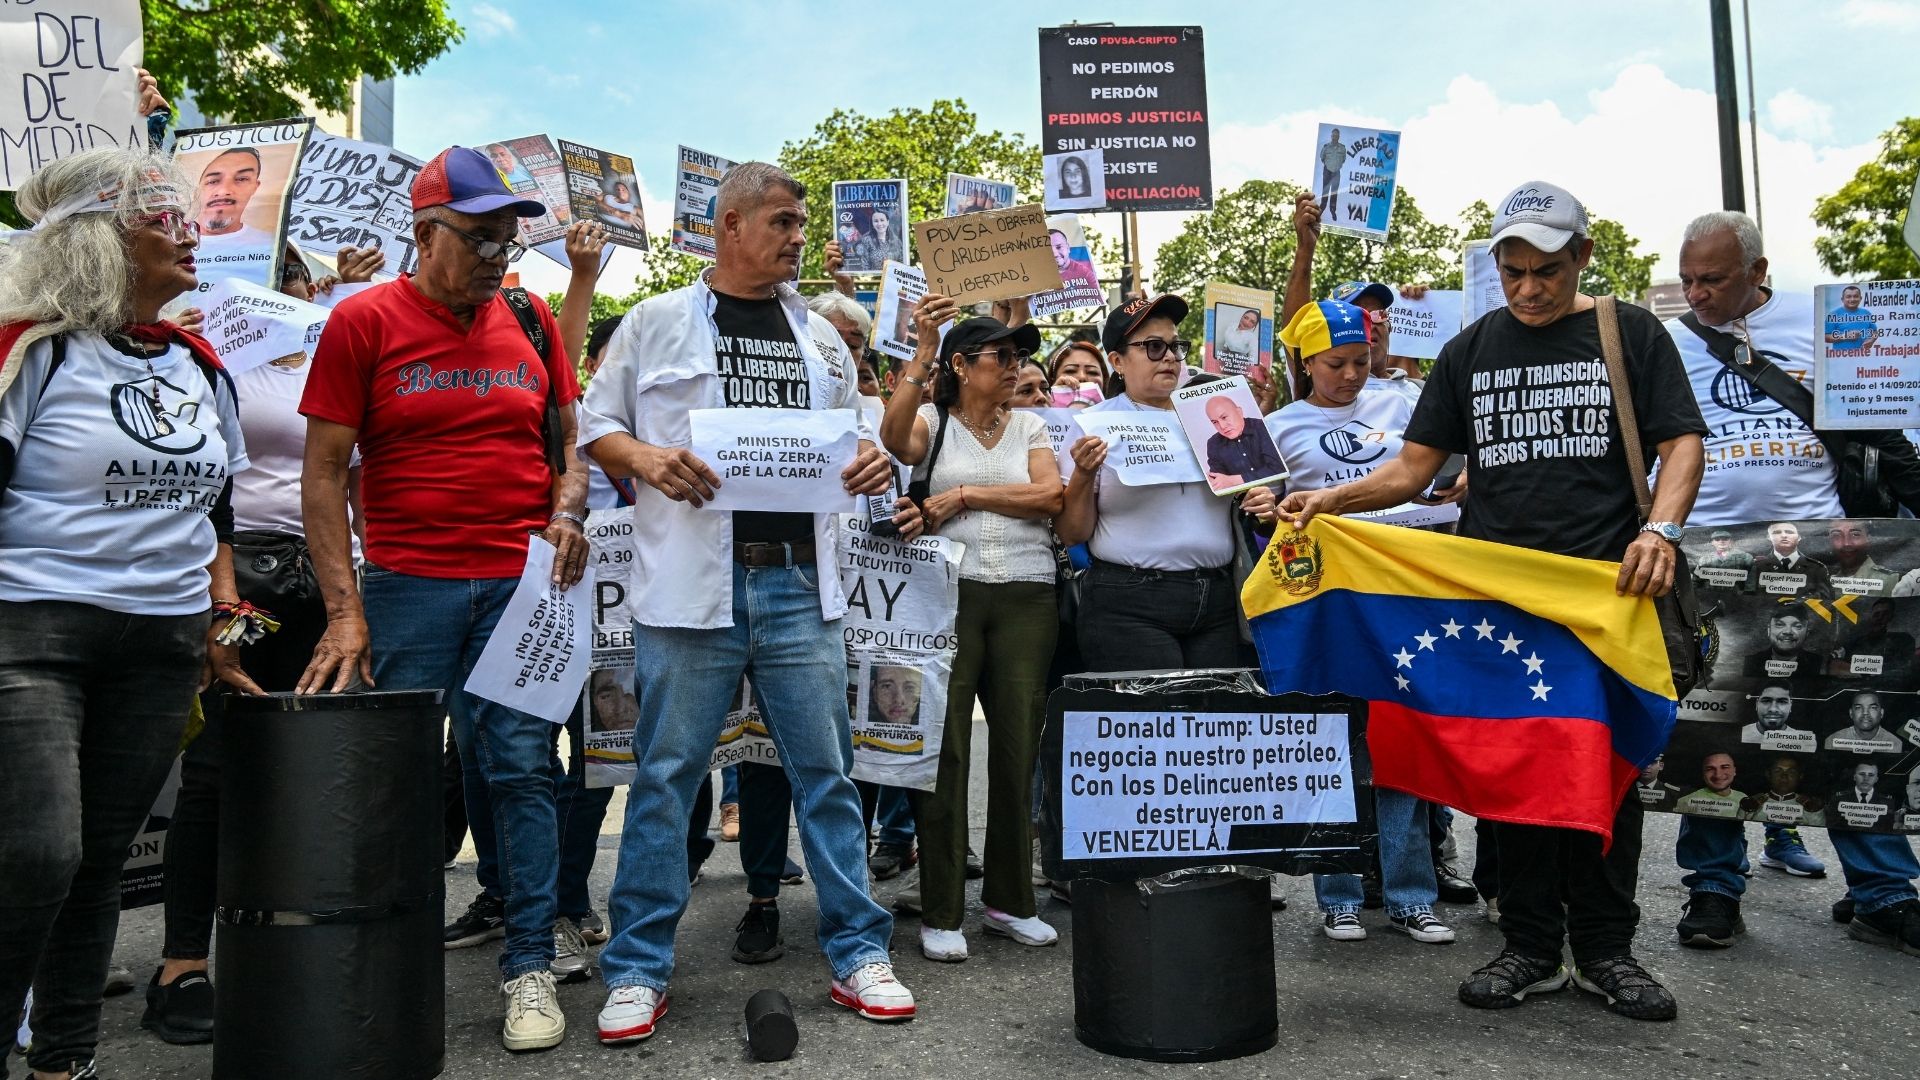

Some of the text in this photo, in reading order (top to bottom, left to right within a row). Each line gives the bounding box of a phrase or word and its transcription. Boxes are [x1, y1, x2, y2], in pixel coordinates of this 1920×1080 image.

[35, 12, 119, 71] DEL
[1068, 36, 1177, 46] CASO PDVSA-CRIPTO
[1072, 61, 1175, 75] NO PEDIMOS
[23, 72, 75, 123] DE
[1091, 84, 1158, 99] PERDÓN
[1048, 110, 1203, 125] PEDIMOS JUSTICIA
[562, 141, 598, 159] LIBERTAD
[1057, 135, 1196, 151] SIN JUSTICIA NO
[1347, 136, 1394, 160] LIBERTAD
[521, 152, 548, 166] AYUDA
[565, 153, 600, 170] KLEIBER
[681, 148, 719, 169] FERNEY
[1359, 156, 1384, 169] PARA
[1103, 161, 1158, 175] EXISTE
[1349, 171, 1388, 187] LERMITH
[837, 184, 897, 202] LIBERTAD
[1349, 183, 1386, 199] LOVERA
[1347, 203, 1368, 223] YA!
[926, 213, 1043, 243] PDVSA OBRERO
[248, 253, 271, 261] Niño
[933, 232, 1051, 273] CARLOS HERNÁNDEZ
[893, 268, 921, 281] Exigimos
[936, 262, 1030, 298] ¡LIBERTAD!
[1071, 277, 1088, 287] PARA
[222, 295, 298, 312] QUEREMOS
[1032, 291, 1063, 306] GUZMÁN
[1863, 290, 1908, 307] Alexander
[1037, 302, 1068, 316] RAMÍREZ
[1388, 306, 1433, 320] ABRA LAS
[1421, 321, 1438, 329] DEL
[1827, 314, 1885, 323] Maluenga
[223, 319, 249, 338] BAJO
[1333, 329, 1364, 338] VENEZUELA
[1825, 343, 1920, 358] Inocente Trabajad
[396, 361, 540, 397] Bengals
[1472, 358, 1610, 392] NO HAY TRANSICIÓN
[1856, 366, 1899, 379] Humilde
[1179, 381, 1238, 400] CARLOS VIDAL
[1826, 382, 1877, 391] Detenido el
[1472, 380, 1611, 418] SIN LA LIBERACIÓN
[1848, 395, 1866, 403] año
[1876, 394, 1882, 402] 9
[1847, 407, 1908, 418] Injustamente
[1135, 425, 1150, 433] DE
[1151, 425, 1169, 434] 400
[1474, 408, 1610, 444] DE TODOS LOS
[737, 436, 811, 448] MINISTRO
[1120, 433, 1167, 442] FAMILIAS
[1743, 432, 1771, 440] POR
[717, 448, 830, 464] GARCÍA ZERPA:
[1128, 443, 1167, 454] EXIGEN
[1479, 432, 1610, 469] PRESOS POLÍTICOS
[1705, 441, 1825, 464] LIBERTAD
[1125, 453, 1175, 467] JUSTICIA!
[1707, 459, 1785, 472] DE LOS PRESOS
[105, 459, 225, 482] ALIANZA
[725, 463, 823, 479] ¡DÉ LA CARA!
[150, 478, 196, 487] POR LA
[139, 502, 180, 511] PRESOS
[850, 536, 938, 563] RAMO VERDE
[598, 553, 610, 564] A
[847, 552, 912, 575] TUCUYITO
[528, 598, 549, 630] SON
[514, 582, 557, 688] DELINCUENTES
[533, 593, 565, 683] SON PRESOS
[549, 602, 574, 682] POLÍTICOS!
[1685, 700, 1727, 712] TODOS
[862, 730, 924, 741] TORTURADO
[1097, 713, 1318, 742] Donald Trump: Usted
[1766, 731, 1797, 740] Jefferson
[1776, 742, 1802, 750] Gedeon
[1069, 739, 1342, 773] negocia nuestro petróleo.
[1071, 771, 1342, 797] Con los Delincuentes que
[1136, 802, 1284, 827] destruyeron a
